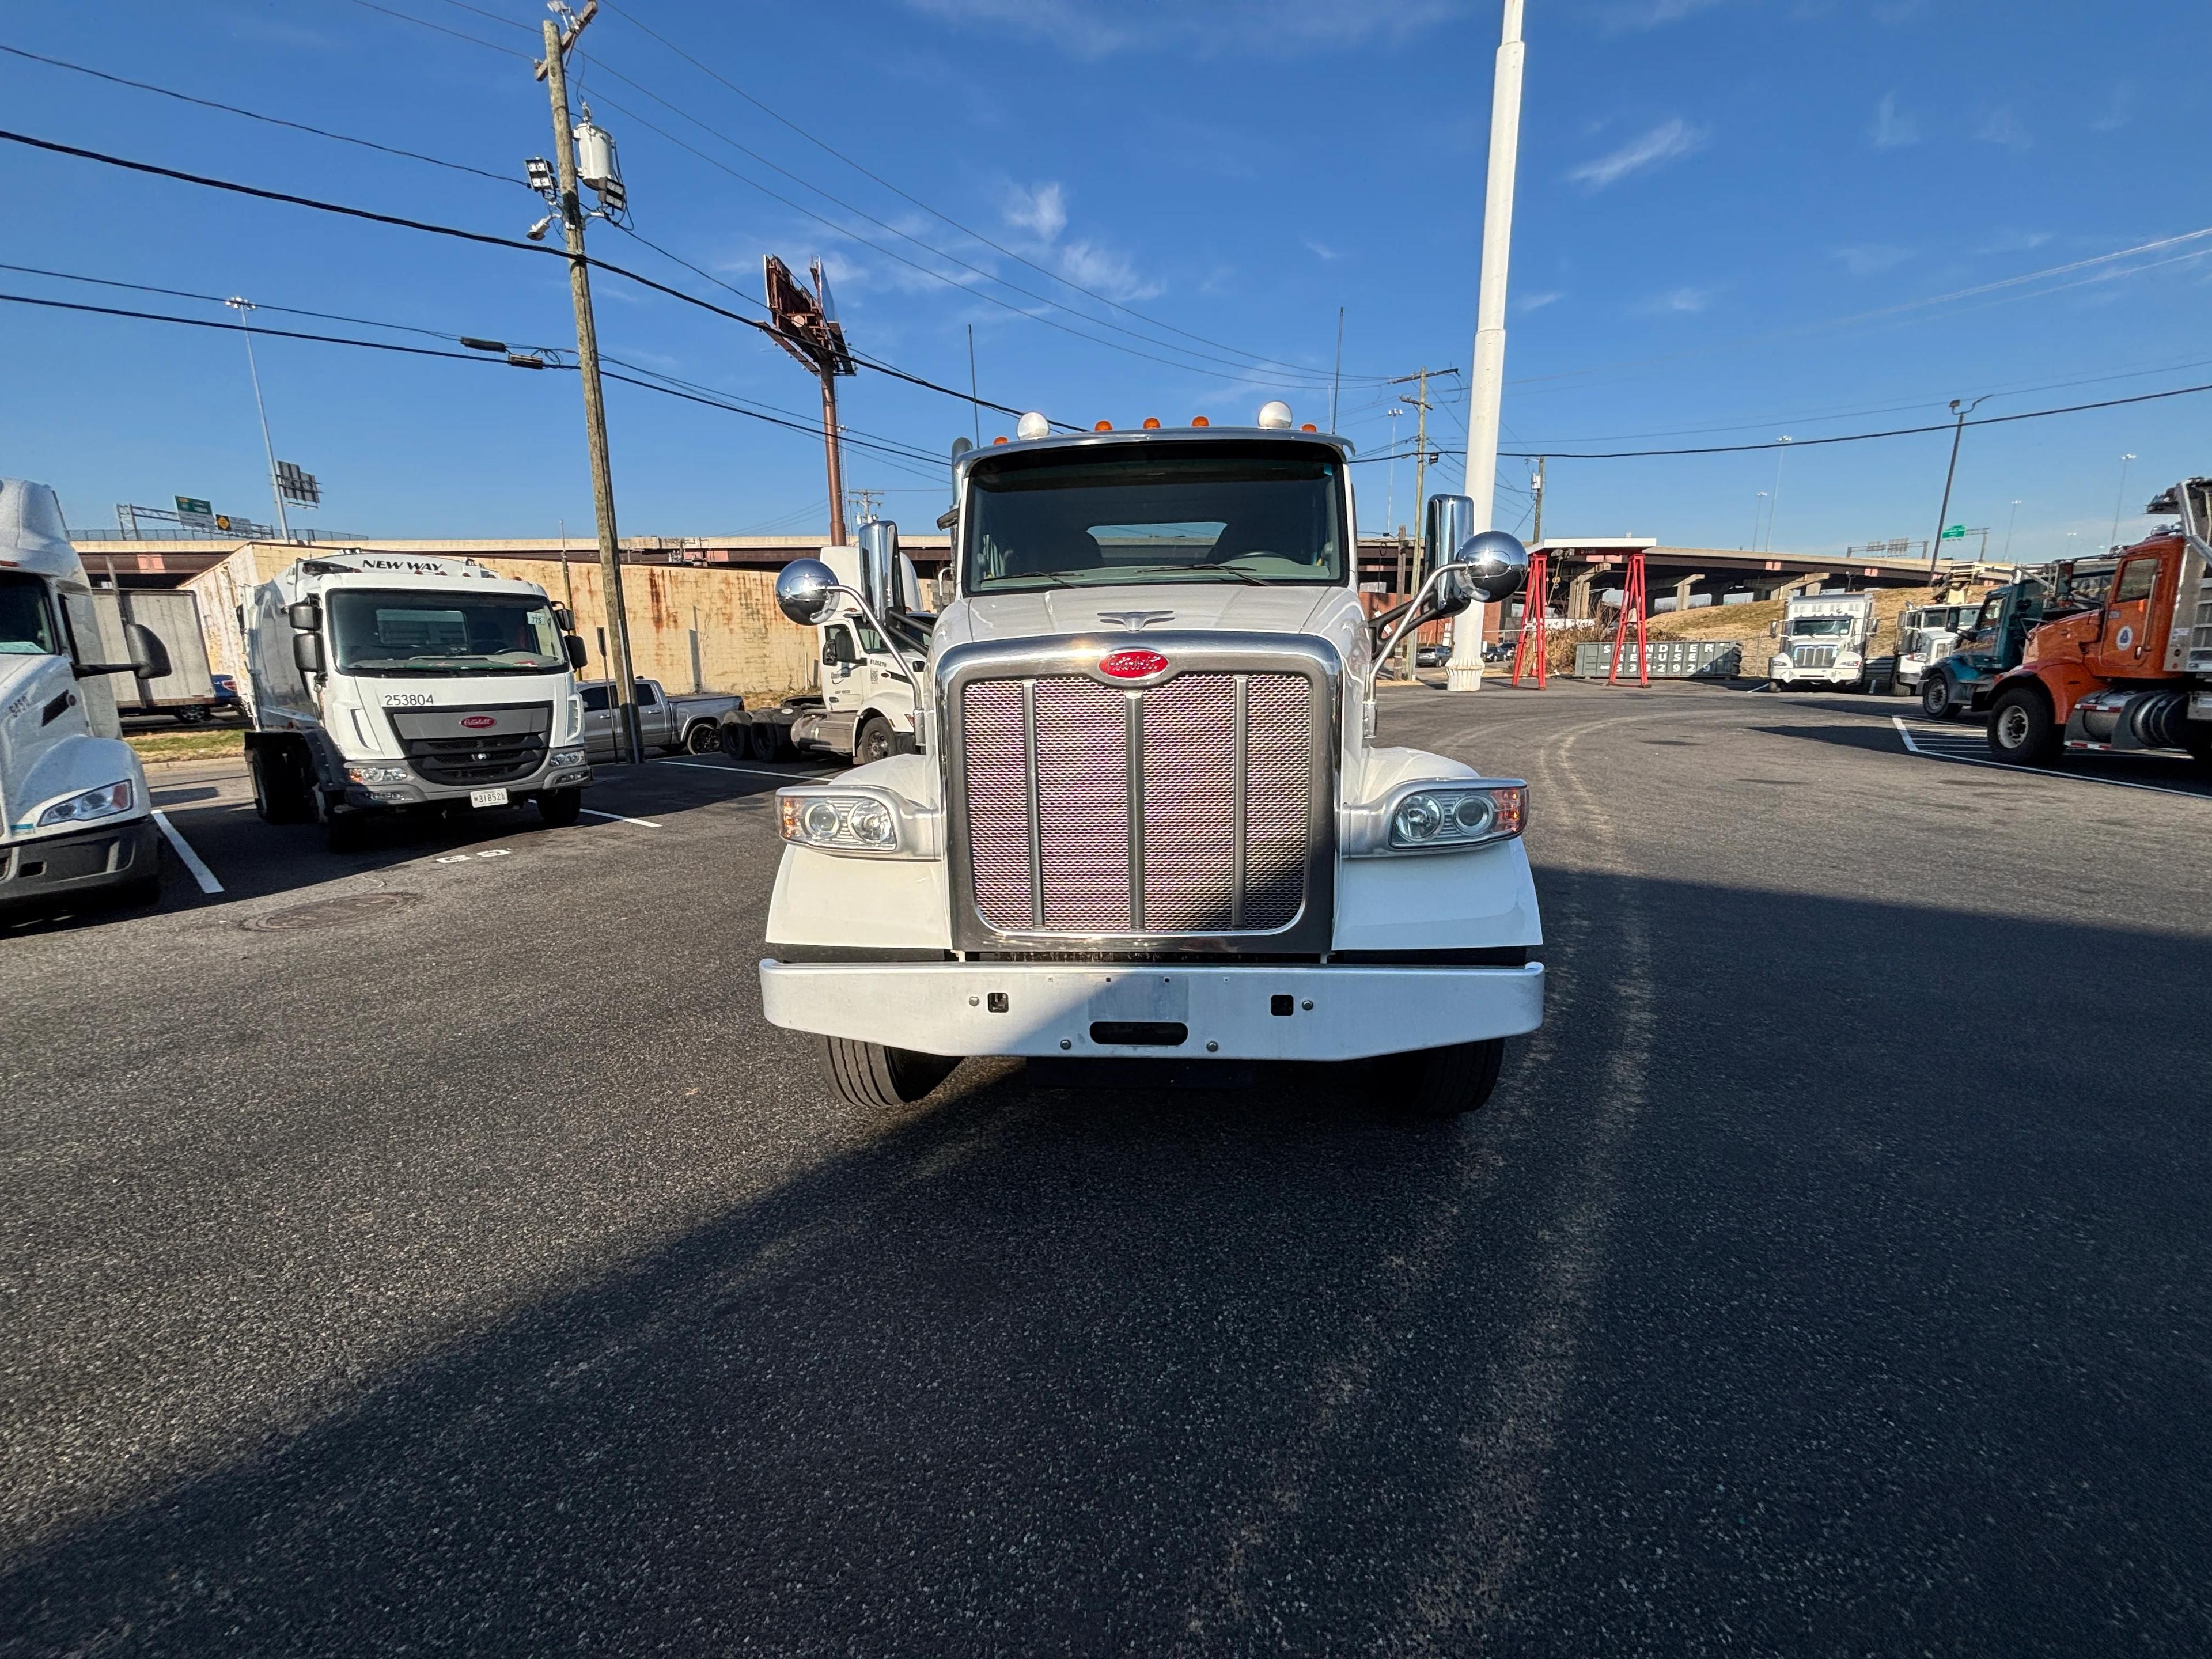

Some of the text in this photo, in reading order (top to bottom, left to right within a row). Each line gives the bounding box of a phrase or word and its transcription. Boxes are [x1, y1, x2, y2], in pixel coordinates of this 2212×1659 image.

[362, 560, 442, 571] NEW WAY
[385, 694, 434, 706] 253804
[479, 793, 501, 802] 31852
